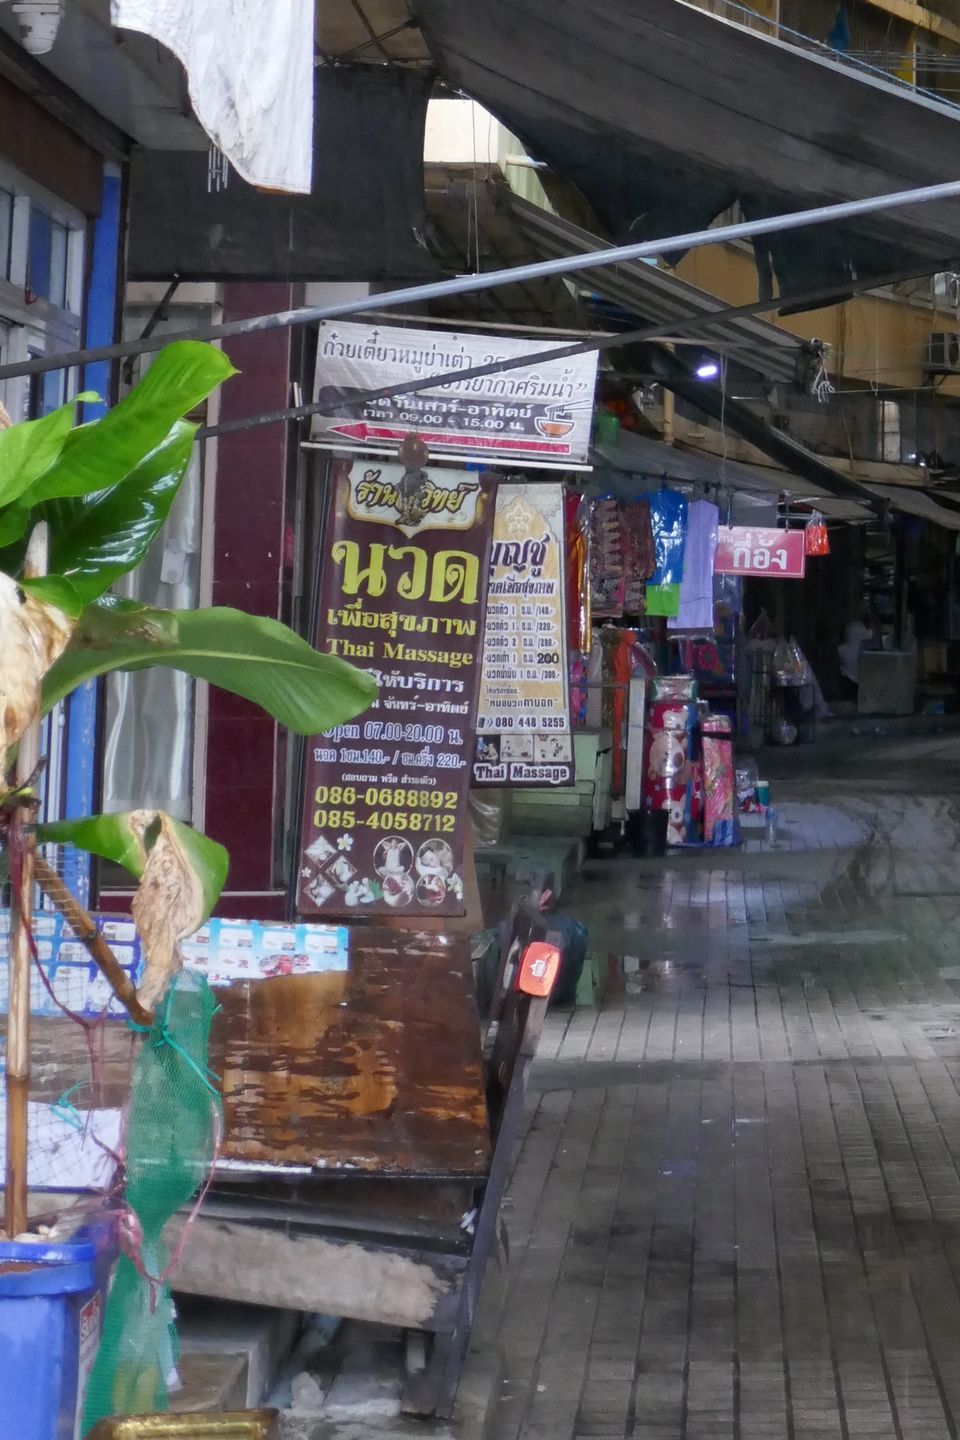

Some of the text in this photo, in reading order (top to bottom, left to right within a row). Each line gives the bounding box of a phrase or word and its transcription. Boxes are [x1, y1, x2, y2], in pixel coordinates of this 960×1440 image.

[399, 411, 443, 424] 09.00
[462, 418, 504, 430] 15.00
[331, 540, 479, 604] นวด
[326, 598, 477, 638] เพื่อสุขภาพ
[326, 638, 474, 669] Thai Massage
[537, 652, 559, 664] 200
[383, 695, 470, 715] จันทร์-อาทิตย์
[363, 721, 445, 744] 07.00-20.00
[495, 716, 565, 729] 080 448 5255
[475, 765, 568, 783] Thai Massage
[314, 786, 458, 809] 086-0688892
[313, 810, 456, 833] 085-4058712
